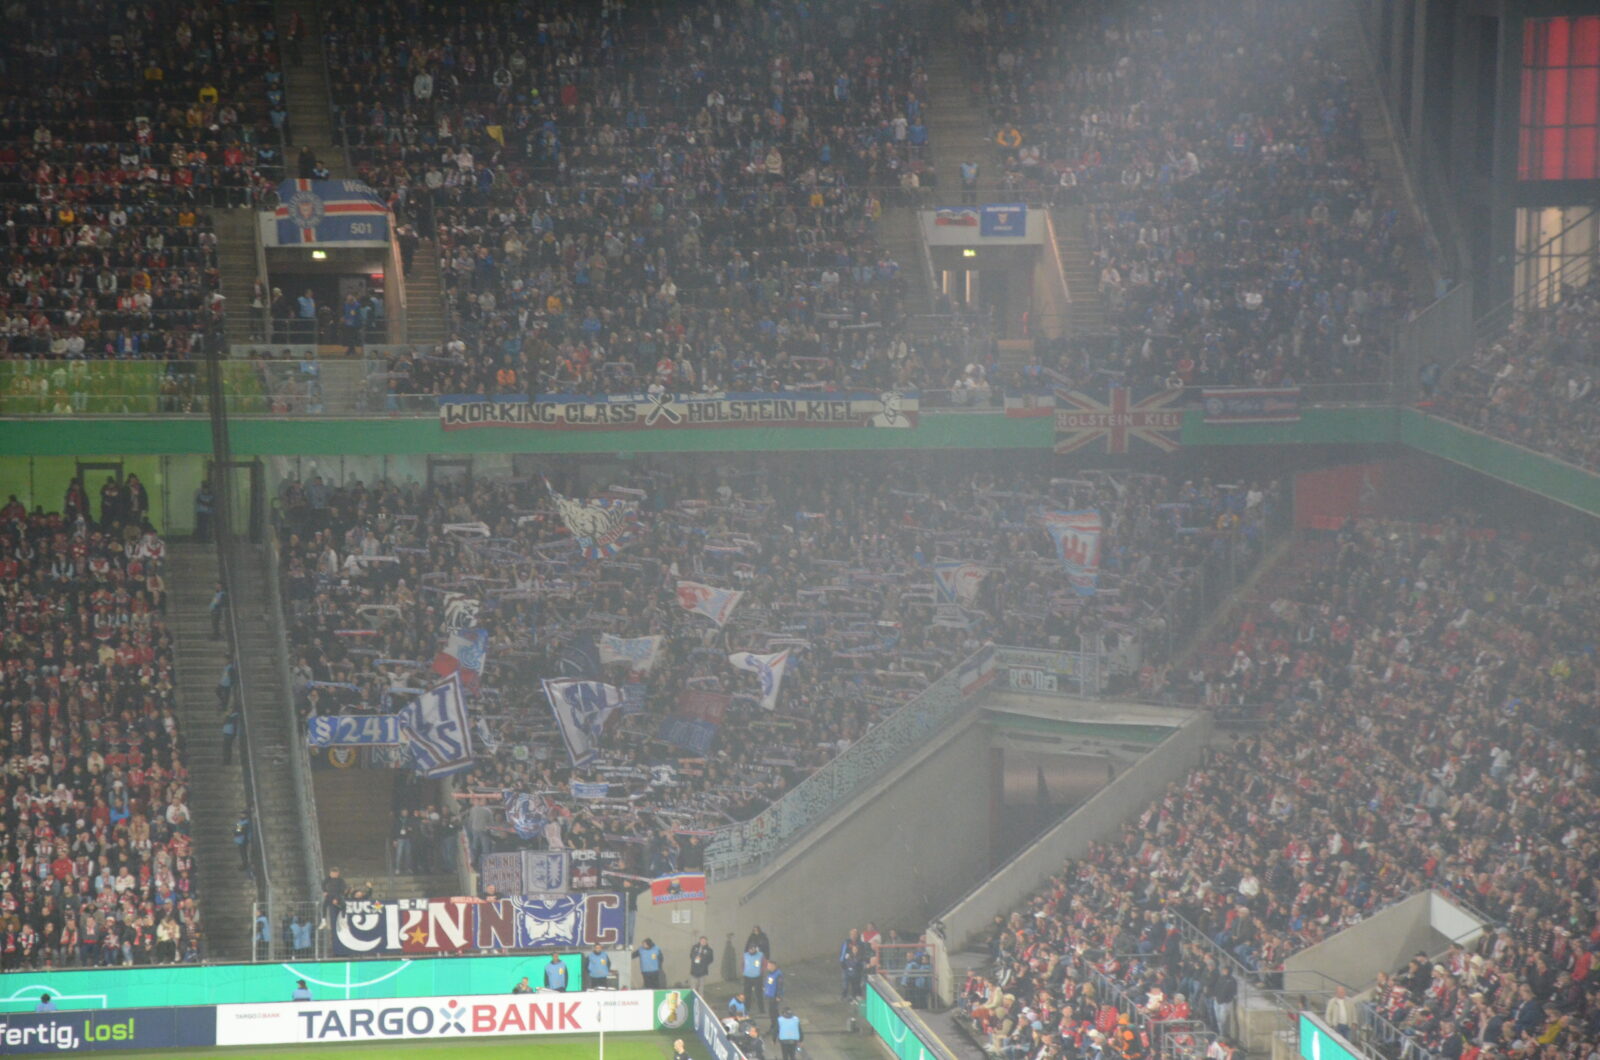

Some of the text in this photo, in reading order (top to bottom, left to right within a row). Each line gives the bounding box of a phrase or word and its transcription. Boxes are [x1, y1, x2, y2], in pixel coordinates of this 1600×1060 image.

[350, 222, 372, 235] 501
[446, 400, 861, 424] WORKING CLASS HOLSTEIN KIEL
[1056, 412, 1179, 428] HOLSTEIN KIEL
[340, 717, 397, 743] 241
[84, 1017, 135, 1042] los!
